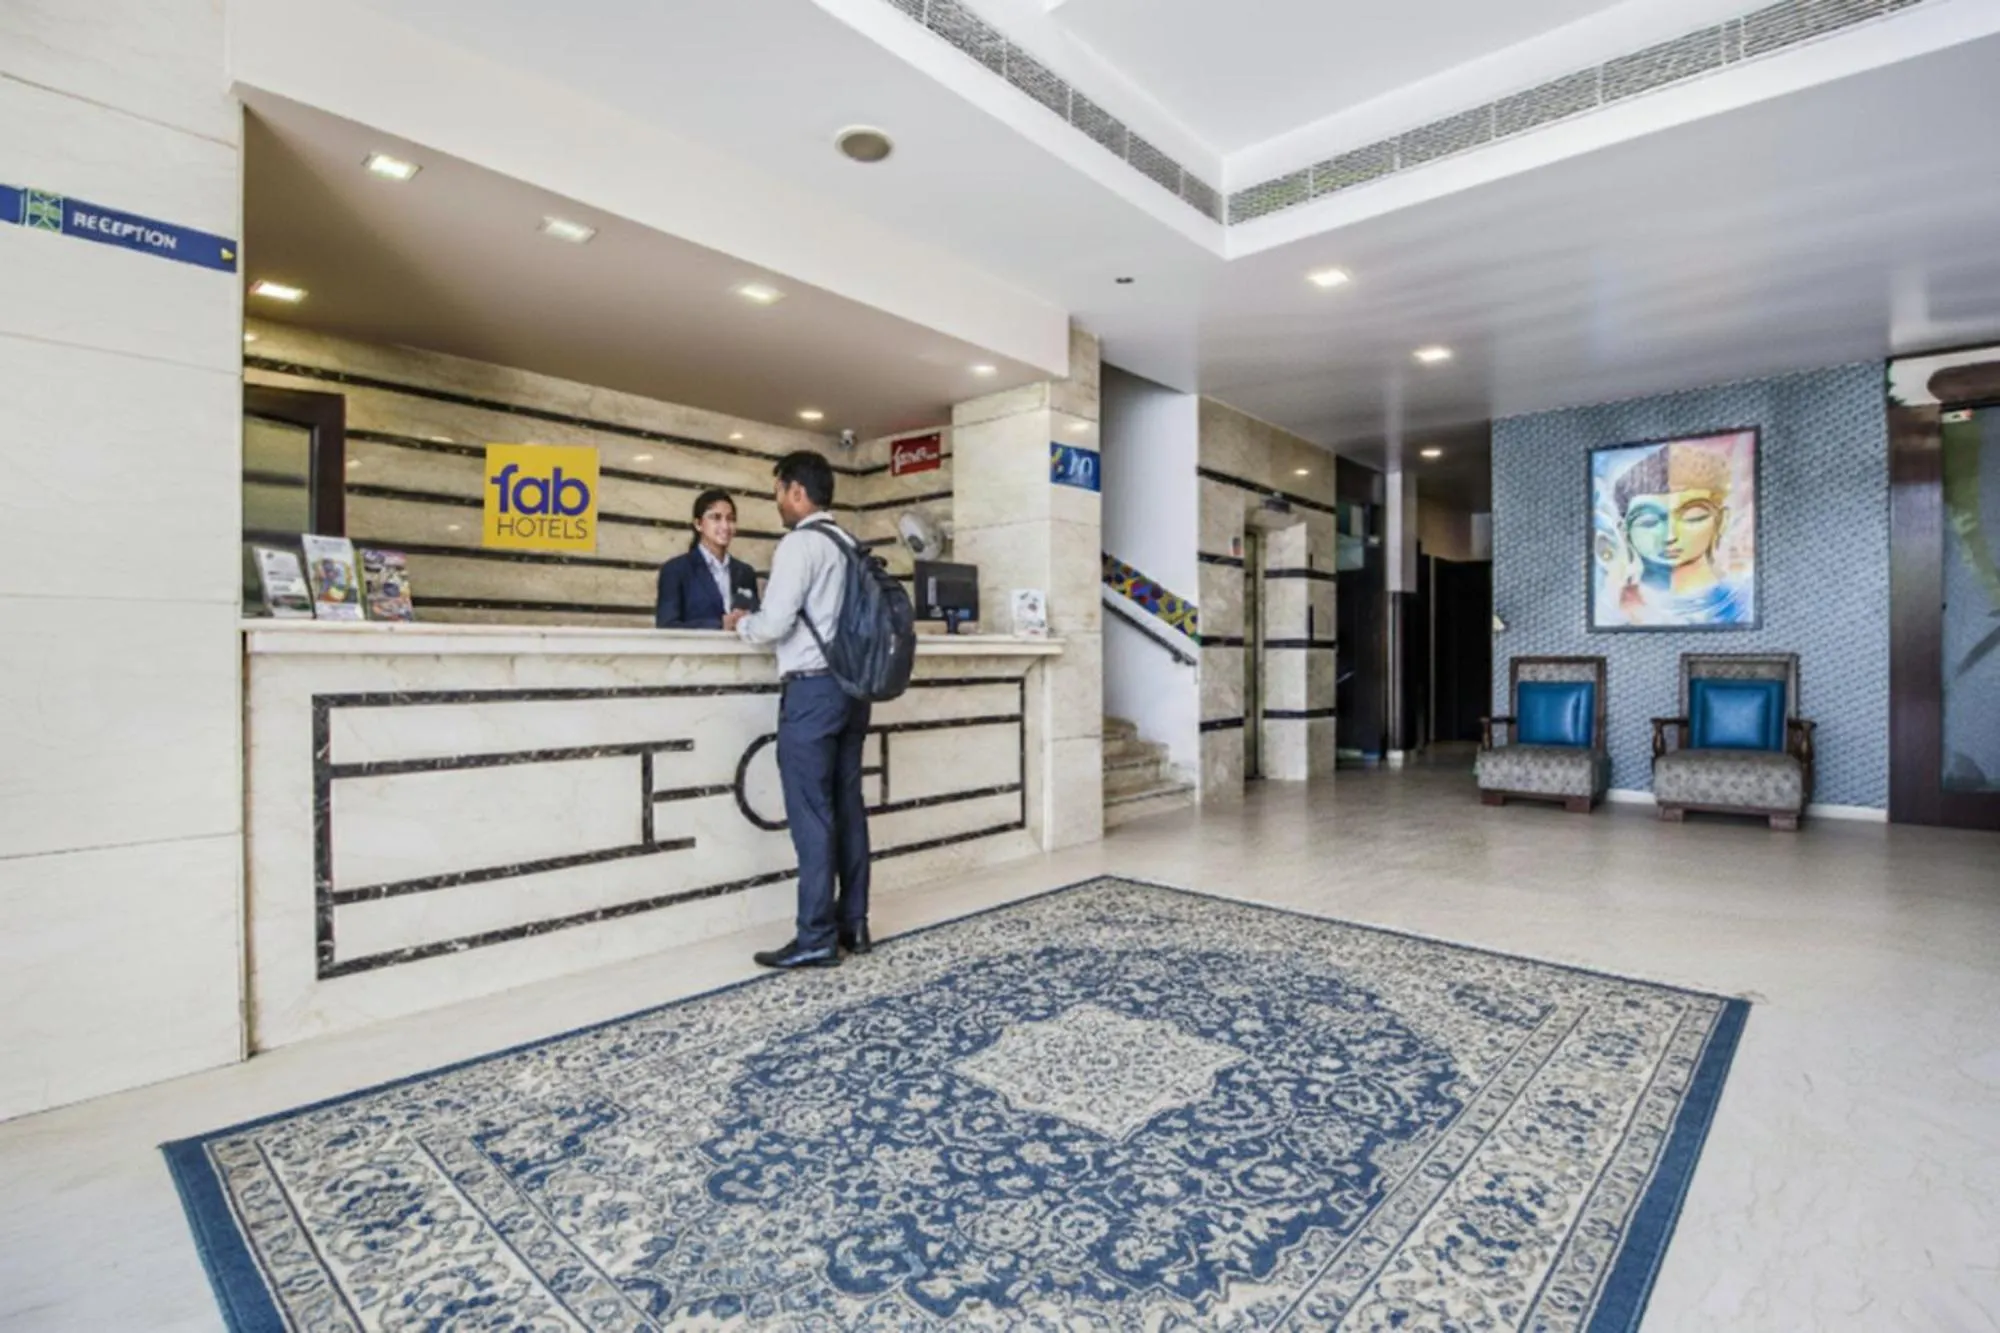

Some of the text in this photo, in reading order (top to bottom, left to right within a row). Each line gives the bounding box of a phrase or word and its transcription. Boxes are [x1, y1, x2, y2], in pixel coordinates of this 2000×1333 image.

[72, 211, 177, 249] RECEPTION
[491, 464, 590, 516] fab
[497, 517, 588, 540] HOTELS
